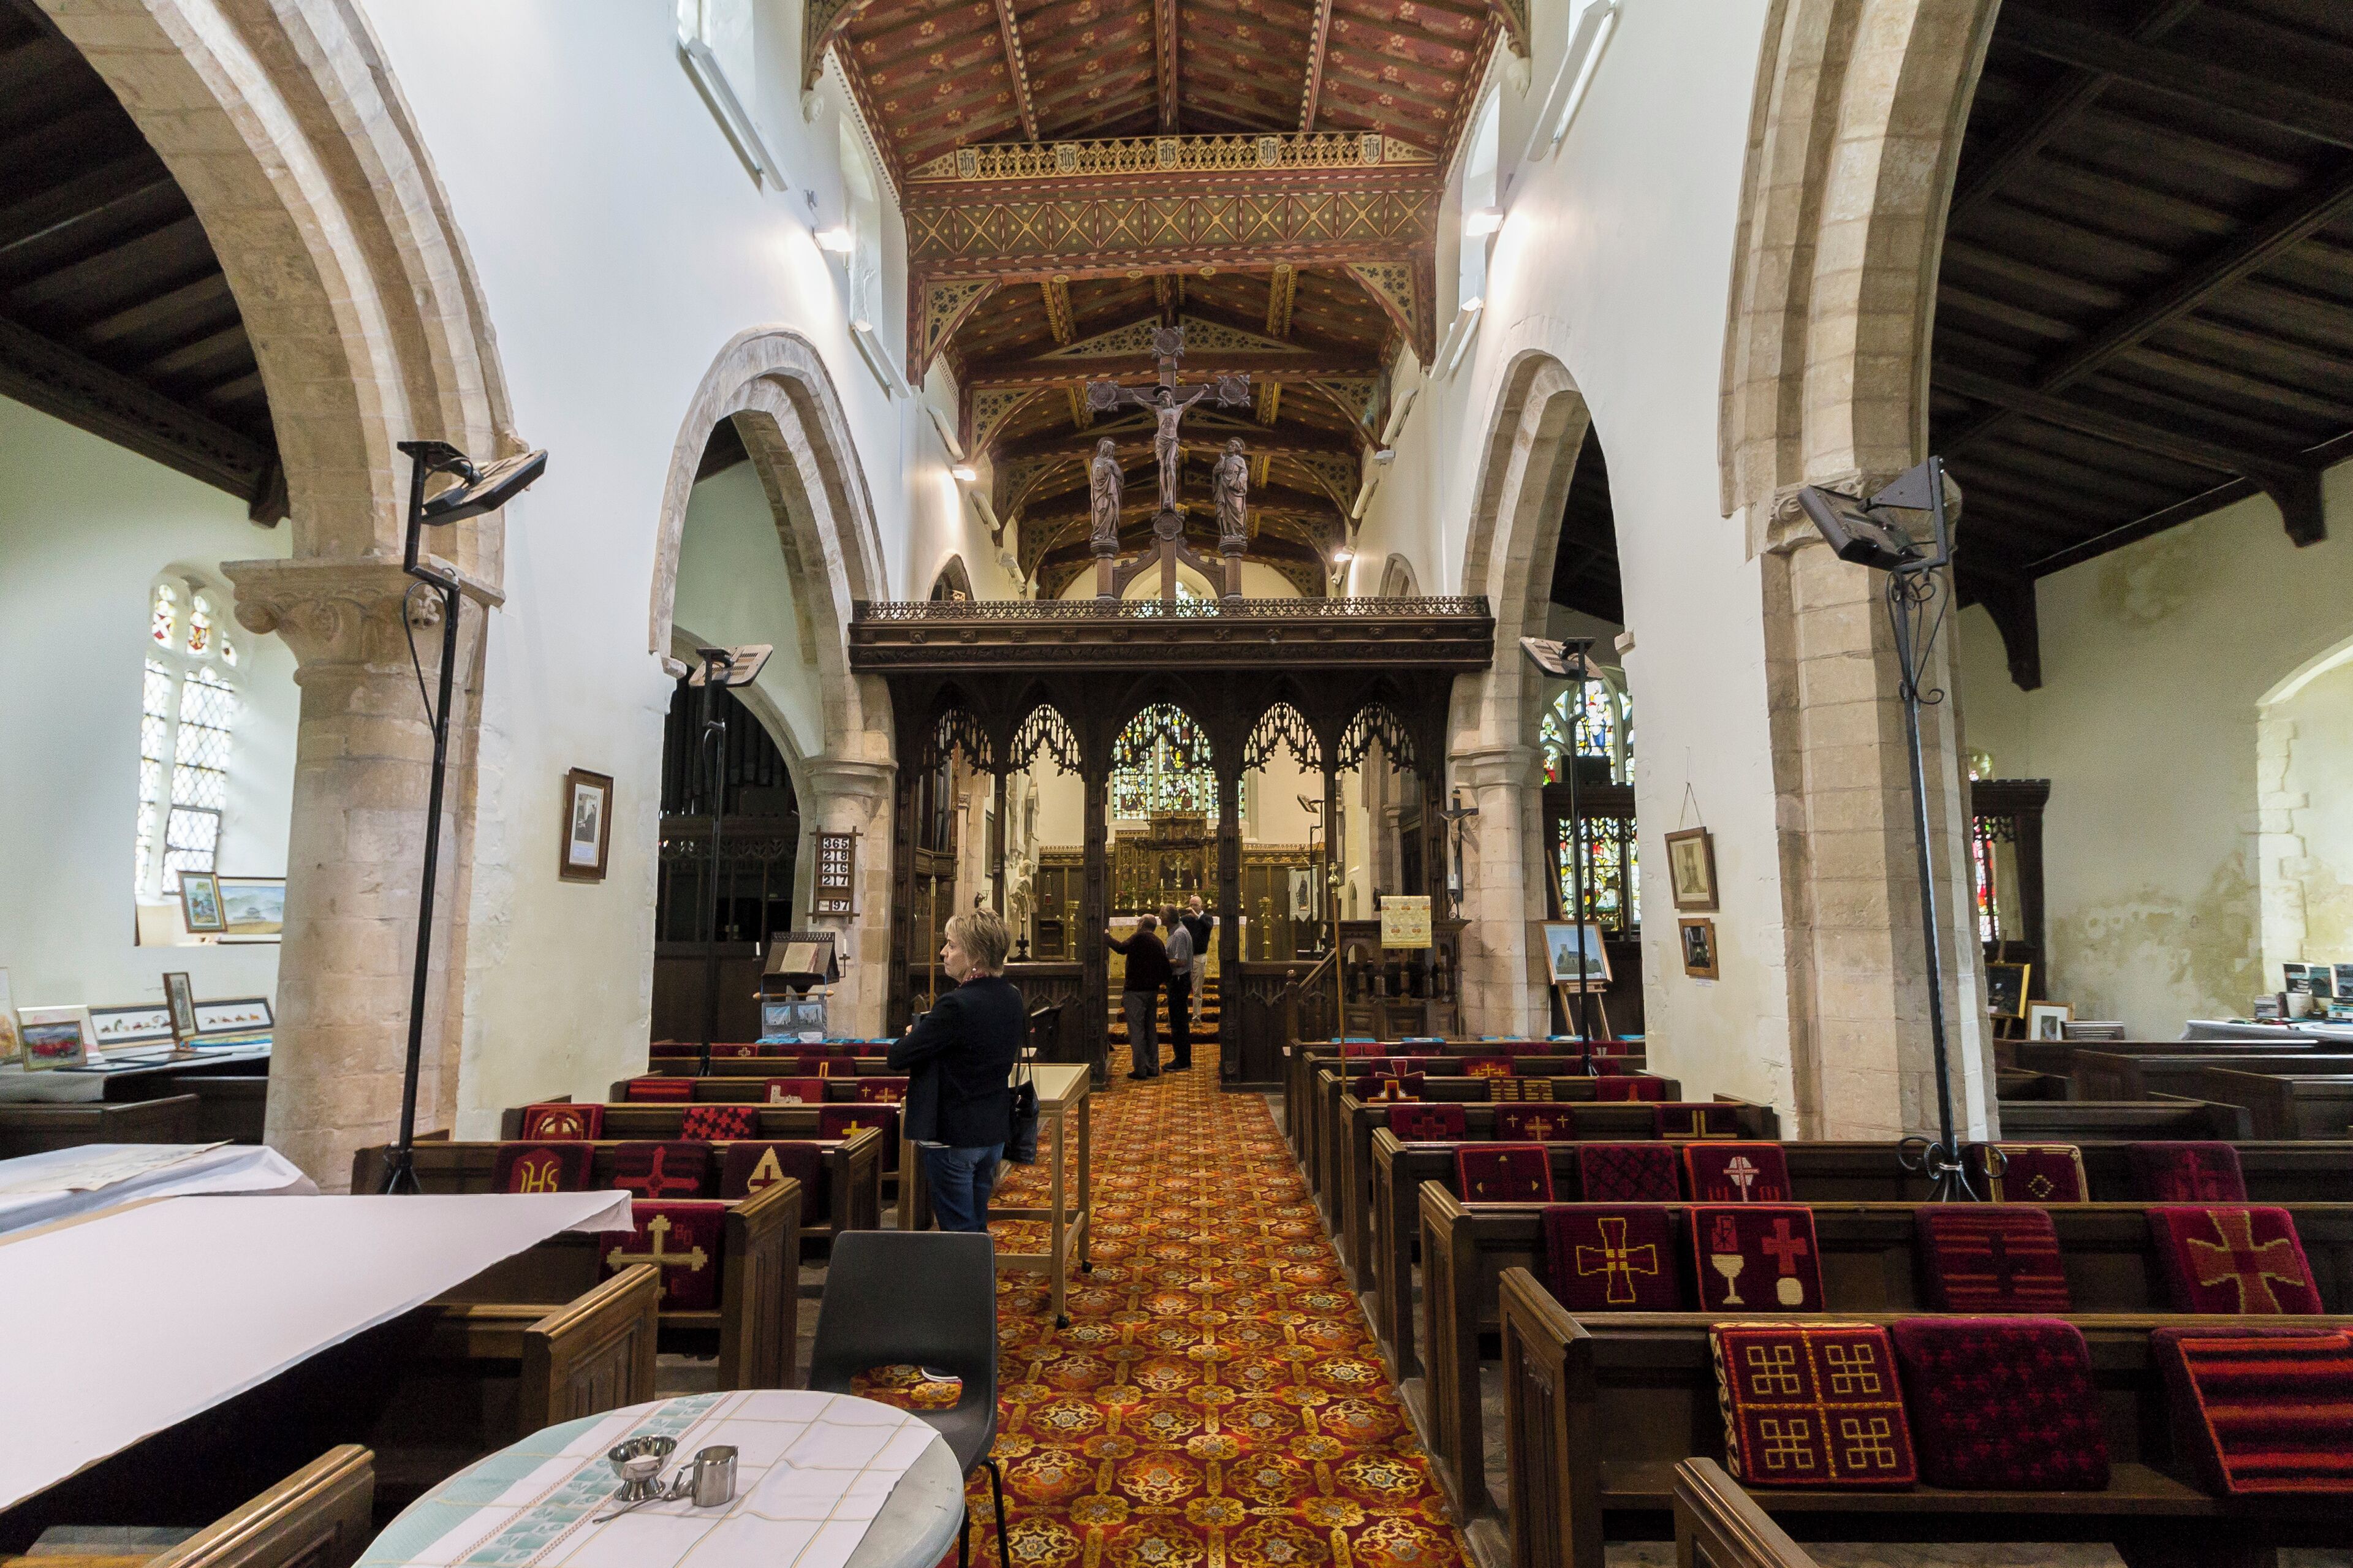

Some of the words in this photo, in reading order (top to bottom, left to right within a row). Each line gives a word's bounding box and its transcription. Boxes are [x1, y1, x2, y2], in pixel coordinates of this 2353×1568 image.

[824, 838, 848, 849] 365
[824, 850, 847, 861] 218
[824, 863, 847, 873] 216
[823, 876, 847, 885] 217
[833, 900, 849, 911] 97
